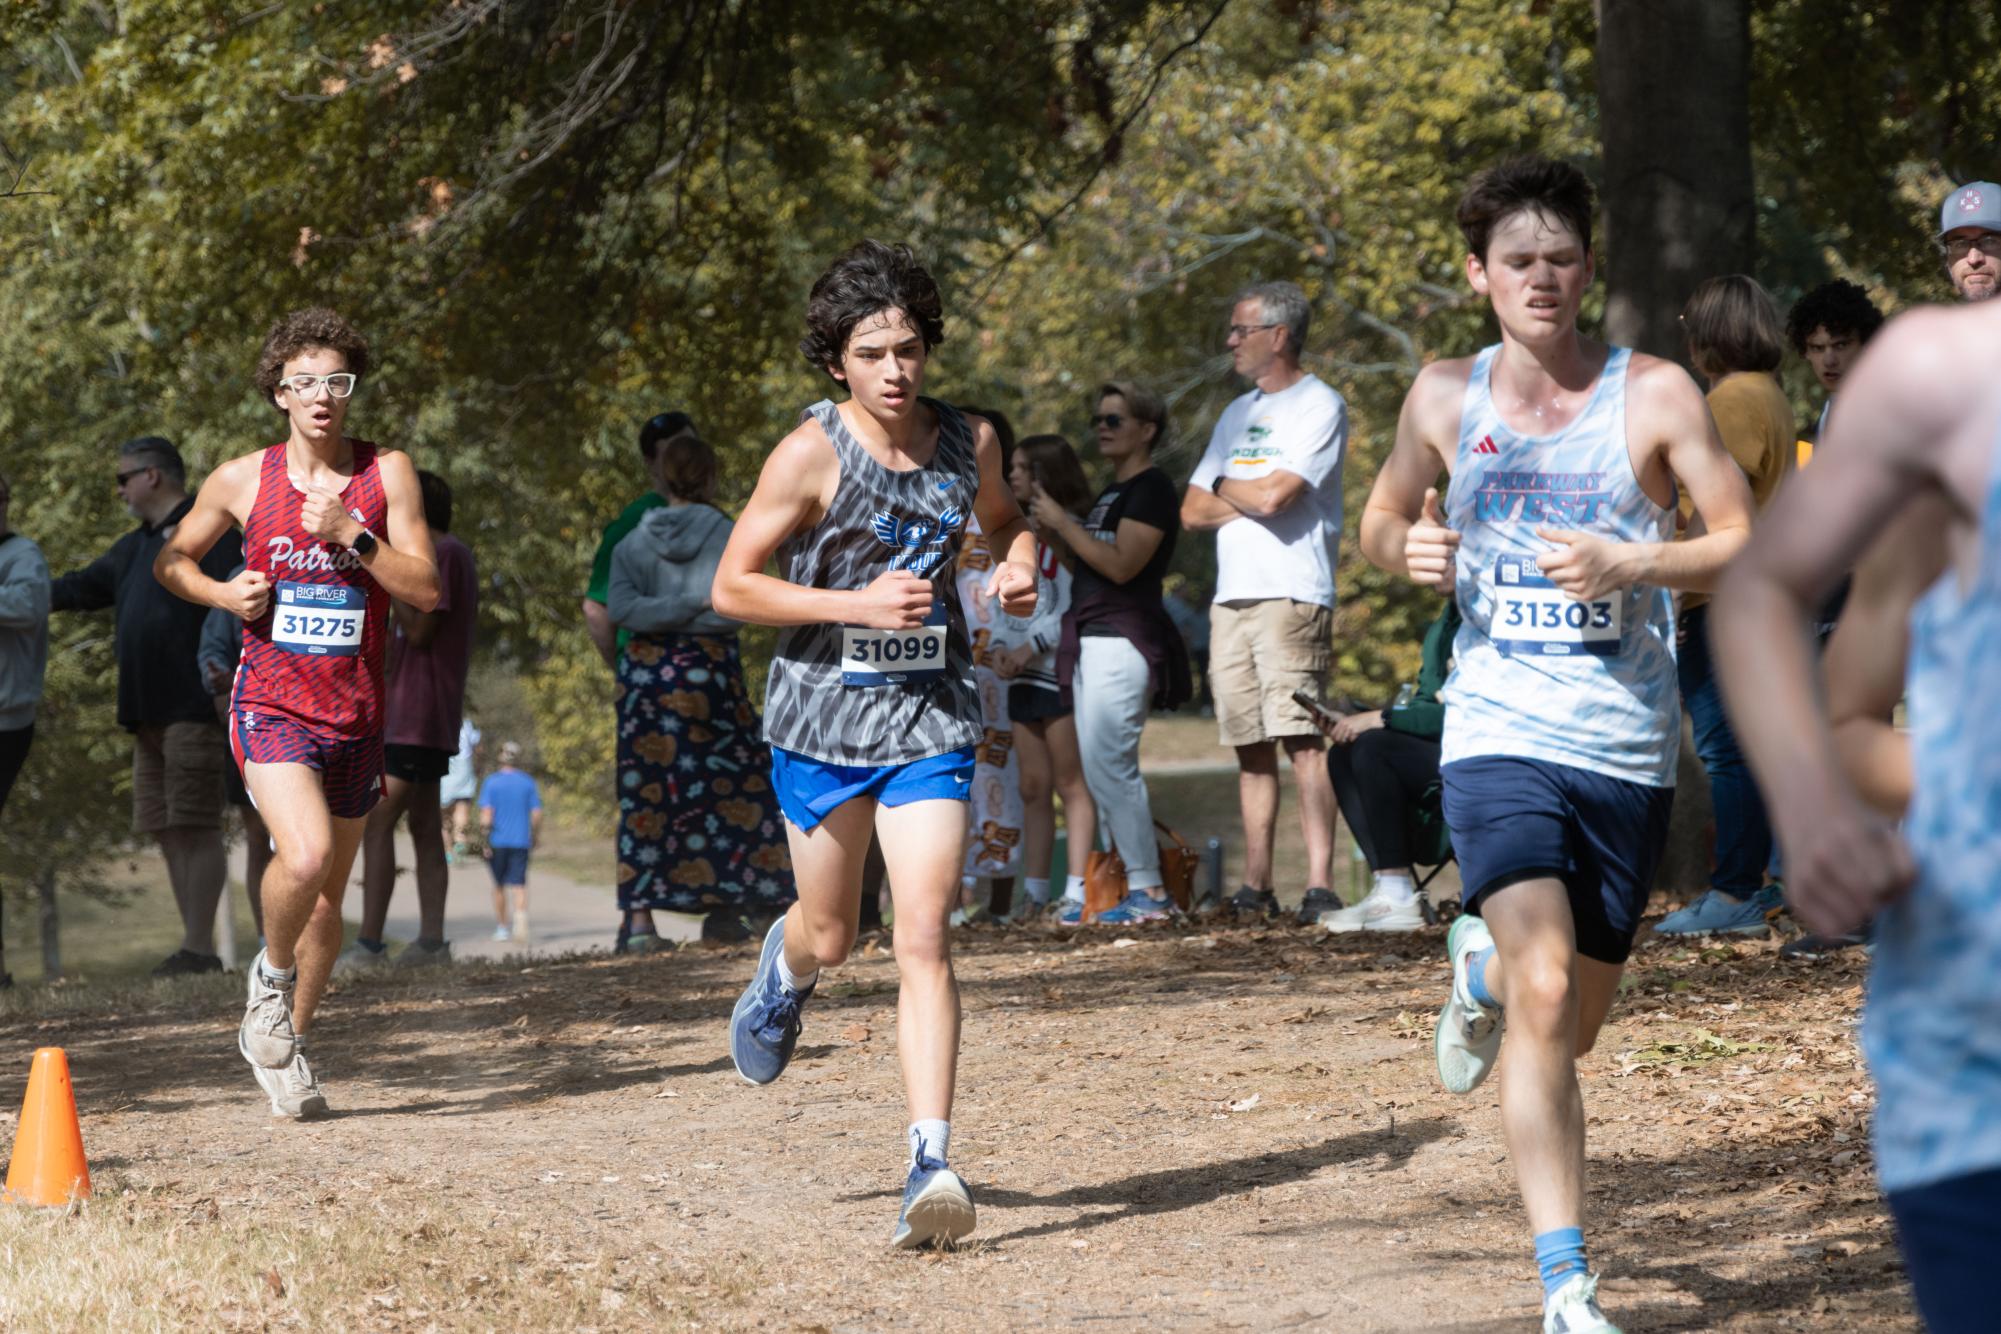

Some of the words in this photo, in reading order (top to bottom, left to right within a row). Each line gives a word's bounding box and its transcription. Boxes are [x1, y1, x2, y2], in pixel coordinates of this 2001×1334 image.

[1483, 471, 1607, 490] PARKWAY
[1473, 490, 1613, 524] WEST
[296, 586, 314, 597] BIG
[316, 588, 346, 599] RIVER
[283, 614, 356, 637] 31275
[1505, 600, 1612, 629] 31303
[851, 636, 940, 662] 31099
